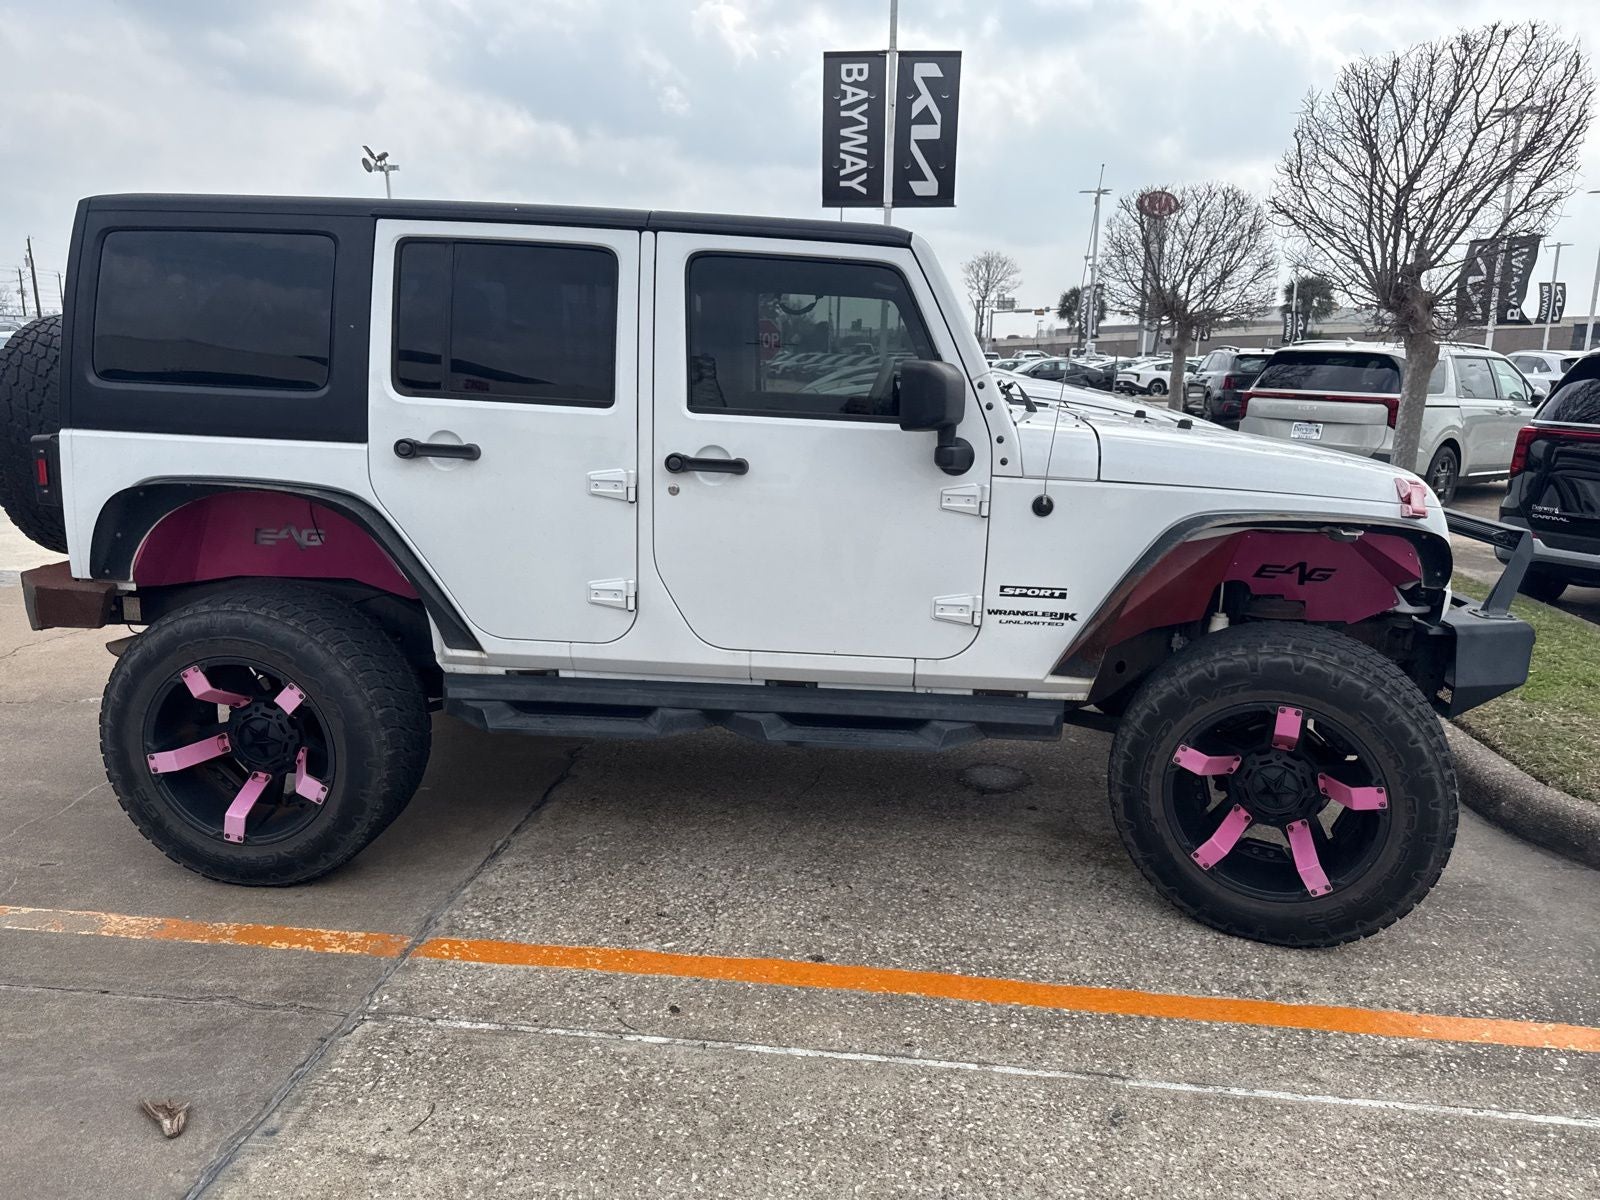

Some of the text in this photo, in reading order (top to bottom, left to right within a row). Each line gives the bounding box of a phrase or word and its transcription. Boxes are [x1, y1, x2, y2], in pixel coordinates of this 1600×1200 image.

[839, 62, 869, 195] BAYWAY
[1539, 285, 1549, 320] BAYWAY
[1532, 514, 1571, 523] CARNIVAL
[1252, 561, 1338, 586] EAG
[1003, 587, 1066, 597] SPORT
[999, 619, 1065, 627] UNLIMITED
